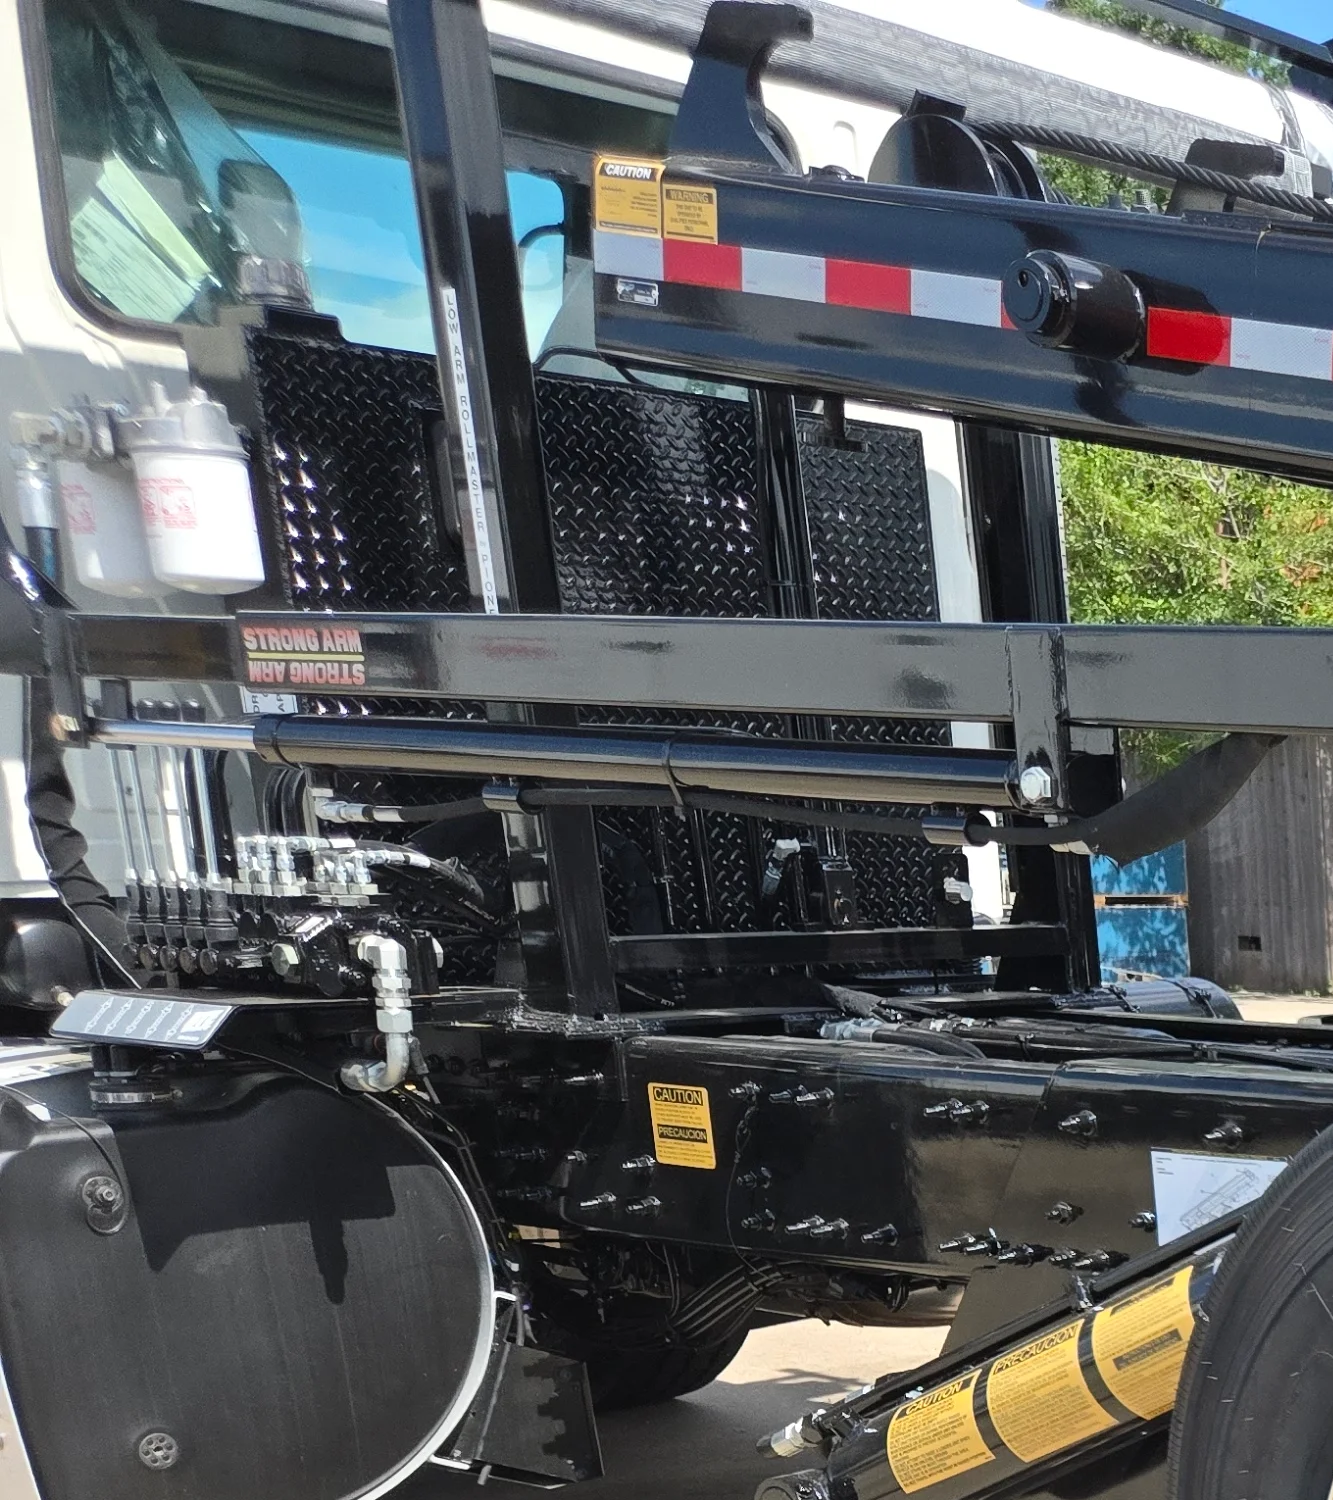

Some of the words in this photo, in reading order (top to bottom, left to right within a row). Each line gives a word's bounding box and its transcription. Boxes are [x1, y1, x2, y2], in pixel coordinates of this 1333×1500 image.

[605, 163, 652, 180] CAUTION
[669, 189, 709, 203] WARNING
[446, 294, 459, 334] LOW
[454, 345, 465, 385] ARM
[460, 396, 485, 532] ROLLMASTER
[242, 626, 320, 652] STRONG
[322, 629, 363, 653] ARM
[248, 660, 287, 684] ARM
[289, 662, 366, 686] STRONG
[654, 1087, 702, 1104] CAUTION
[658, 1126, 707, 1140] PRECAUCION
[993, 1325, 1078, 1375] PRECAUCION
[905, 1381, 964, 1416] CAUTION
